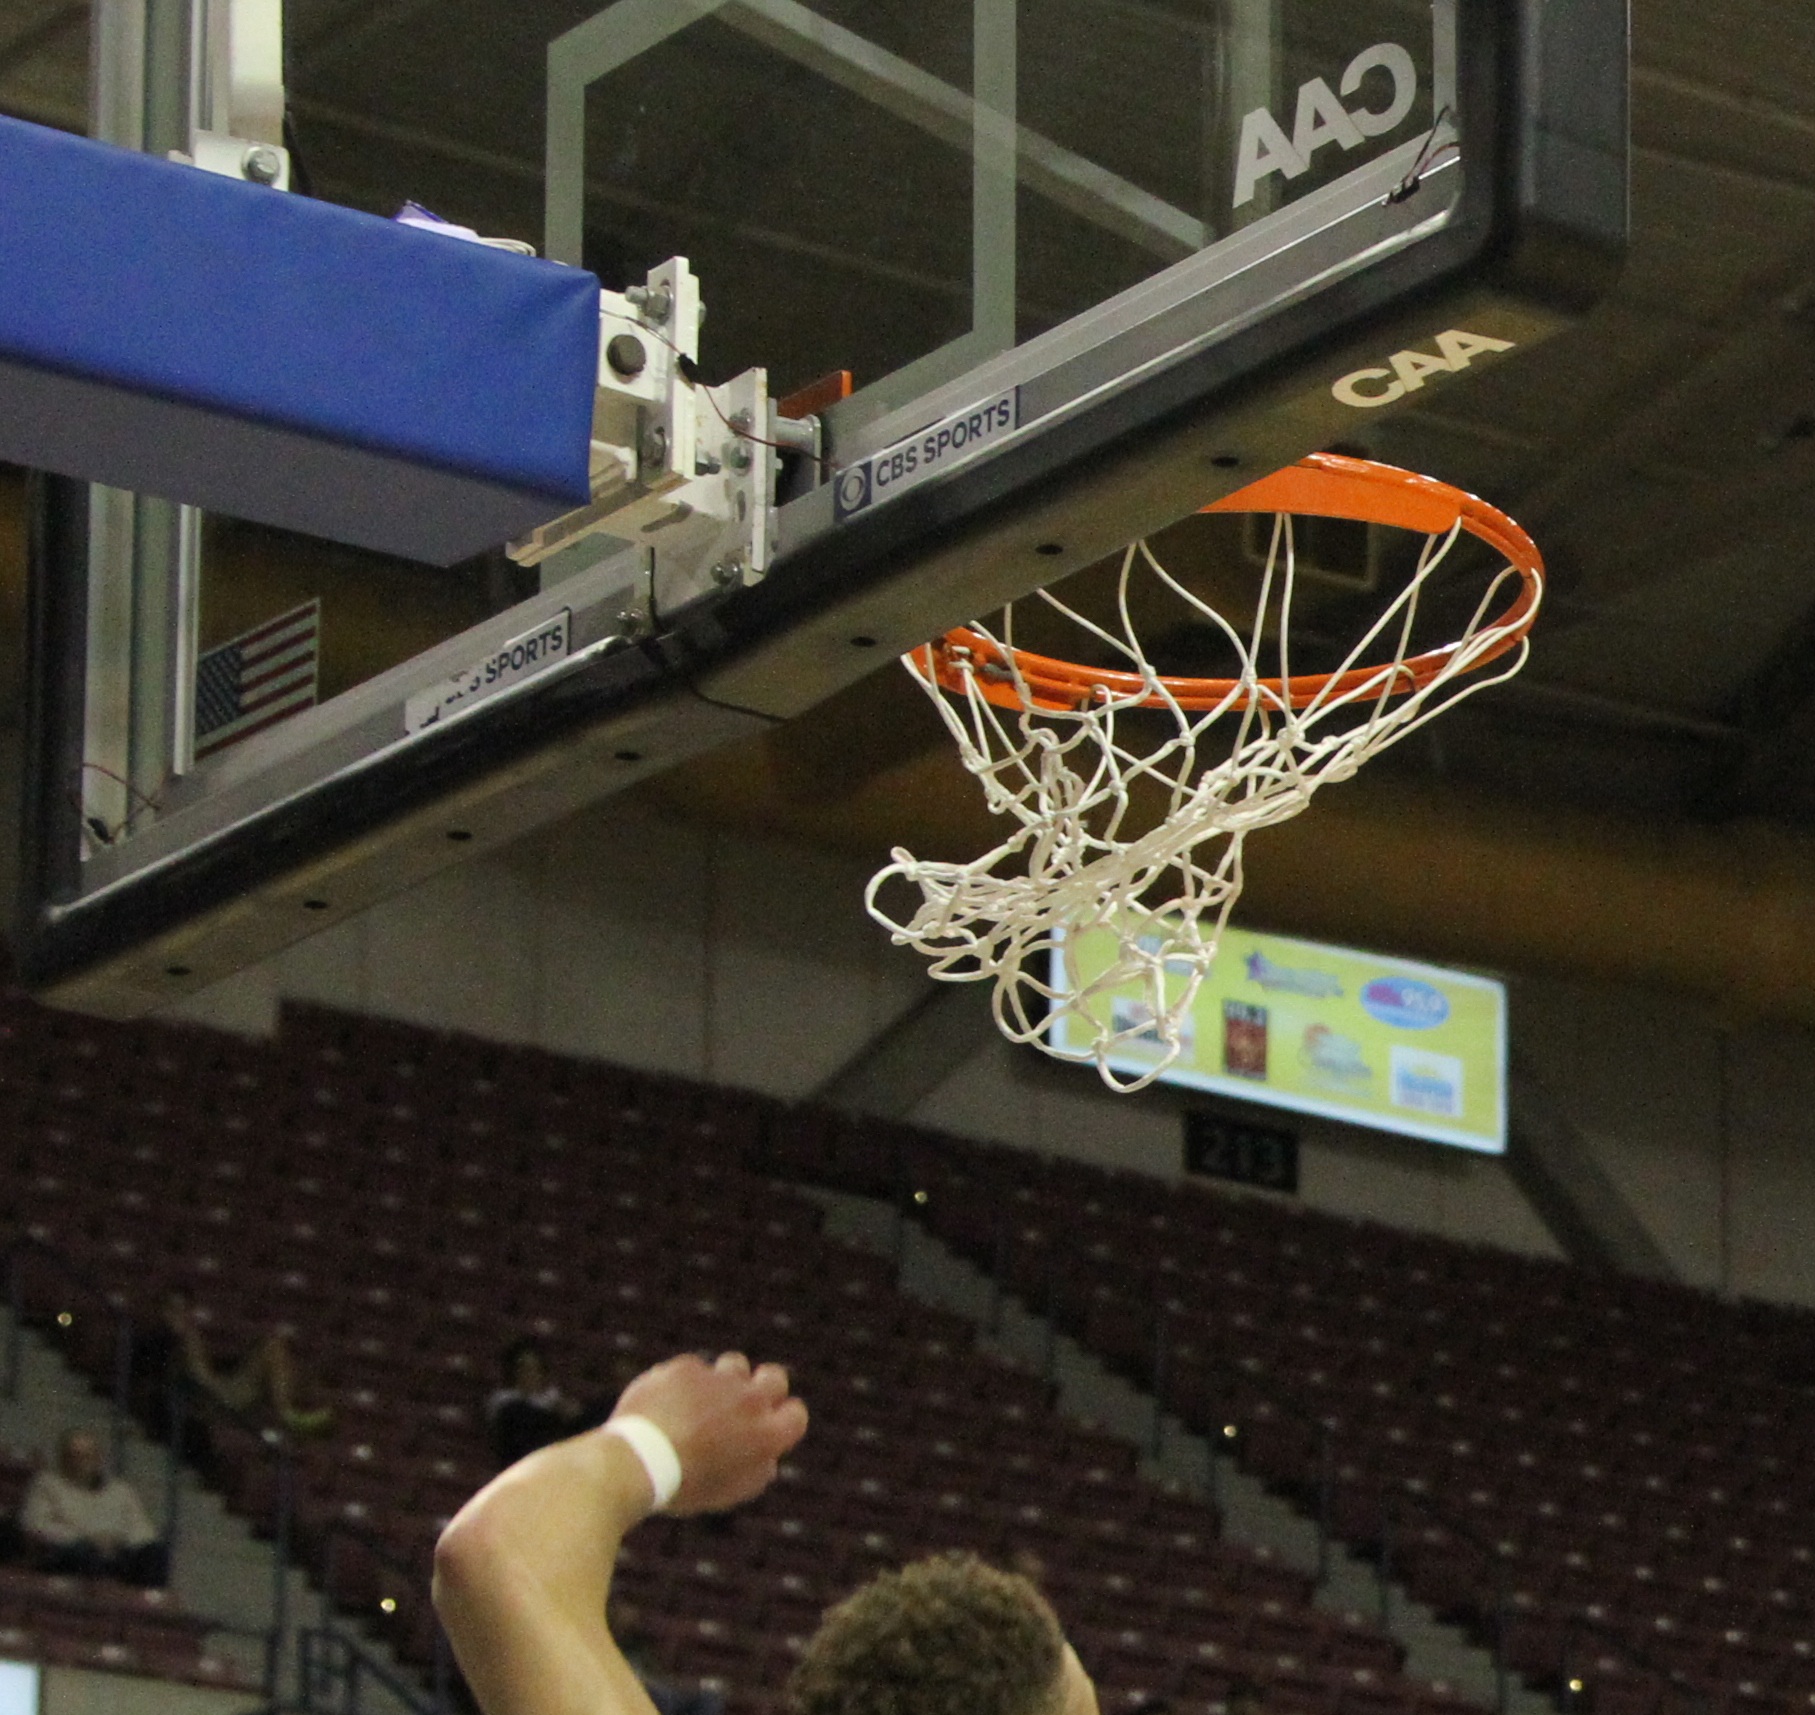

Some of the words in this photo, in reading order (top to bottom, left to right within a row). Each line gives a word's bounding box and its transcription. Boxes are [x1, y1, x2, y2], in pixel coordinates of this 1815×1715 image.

[1332, 329, 1516, 408] CAA
[876, 446, 918, 487] CBS
[923, 399, 1011, 464] SPORTS
[485, 624, 563, 684] SPORTS
